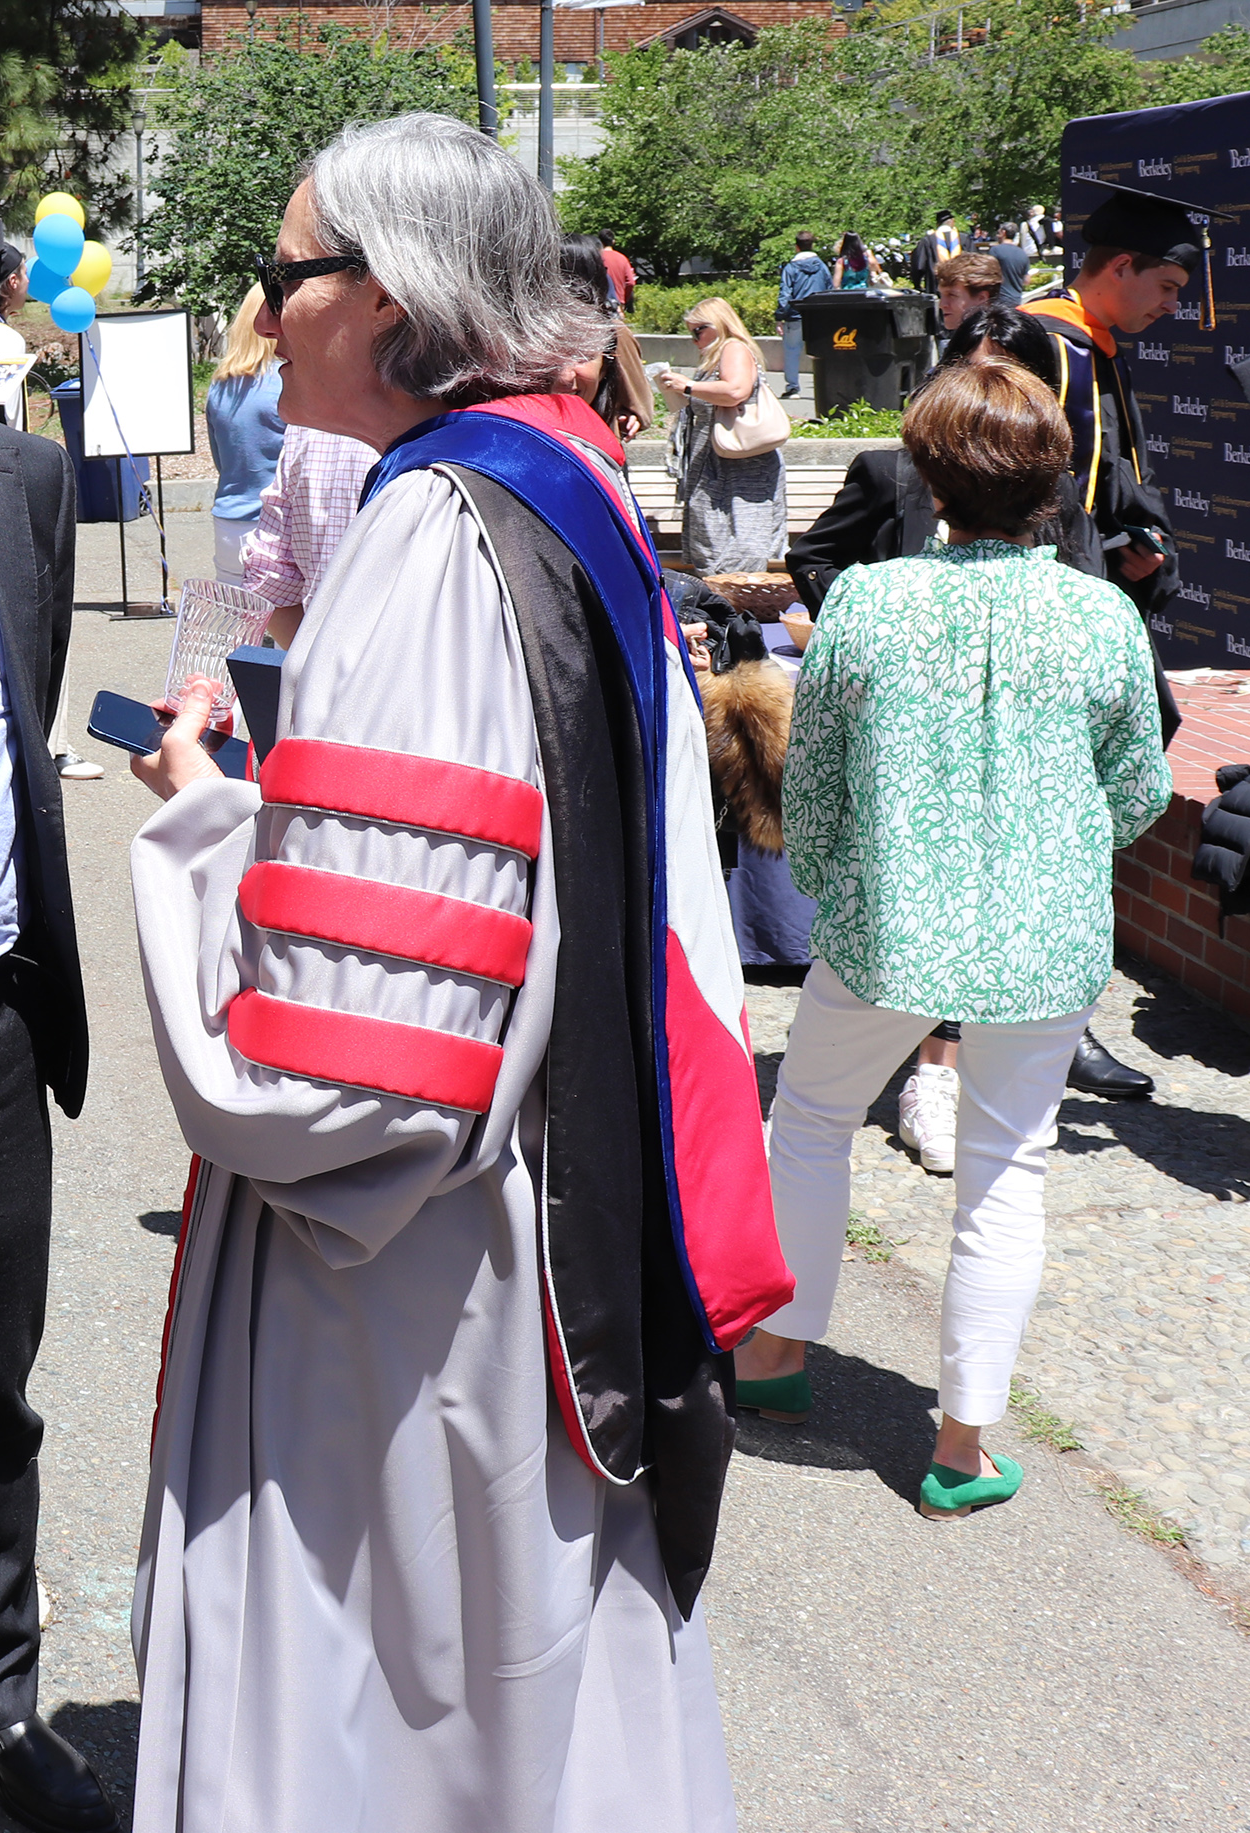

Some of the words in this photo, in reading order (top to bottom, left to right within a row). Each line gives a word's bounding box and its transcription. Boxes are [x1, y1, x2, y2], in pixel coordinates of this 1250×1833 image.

[1138, 158, 1172, 181] Berkeley
[833, 327, 857, 348] Cal
[1138, 341, 1170, 367] Berkeley
[1173, 395, 1208, 422] Berkeley
[1174, 488, 1210, 517] Berkeley
